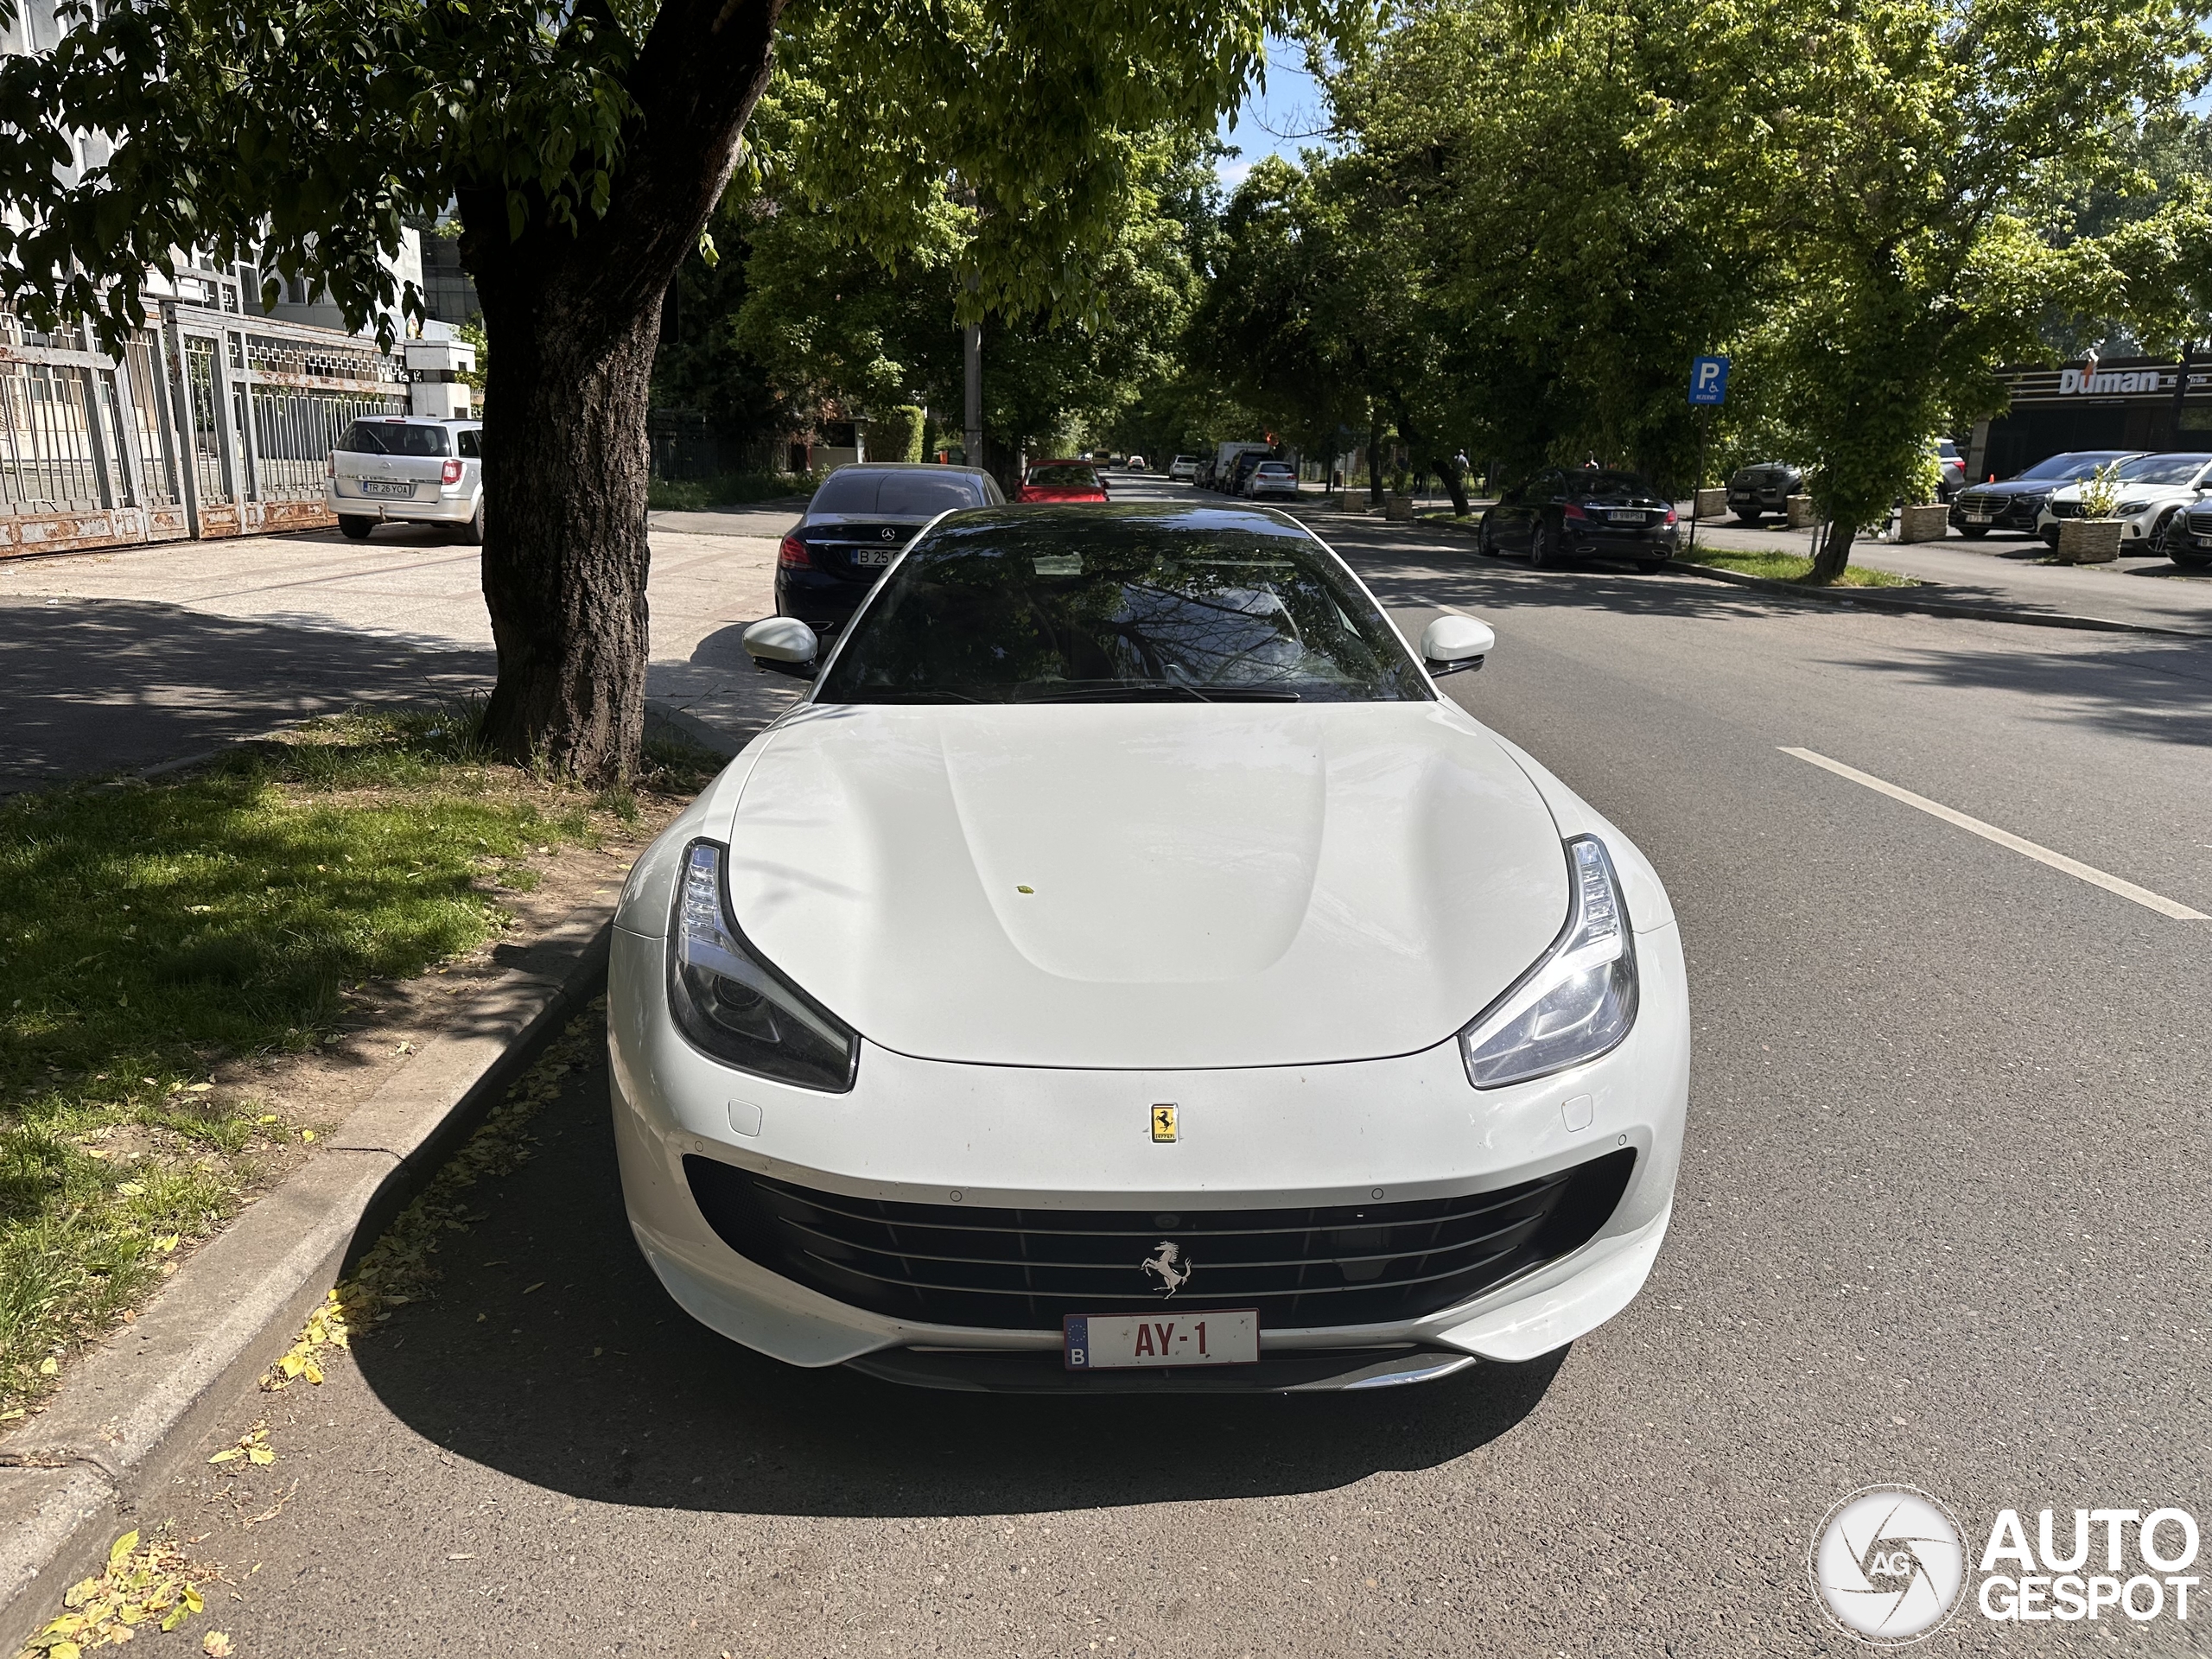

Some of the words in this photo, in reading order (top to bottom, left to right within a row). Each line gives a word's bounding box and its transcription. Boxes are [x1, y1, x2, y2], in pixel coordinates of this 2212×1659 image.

[1699, 363, 1719, 389] P
[2059, 369, 2159, 394] Duman
[860, 550, 868, 563] B
[874, 551, 888, 563] 25
[1135, 1322, 1206, 1357] AY-1
[1071, 1349, 1084, 1364] B
